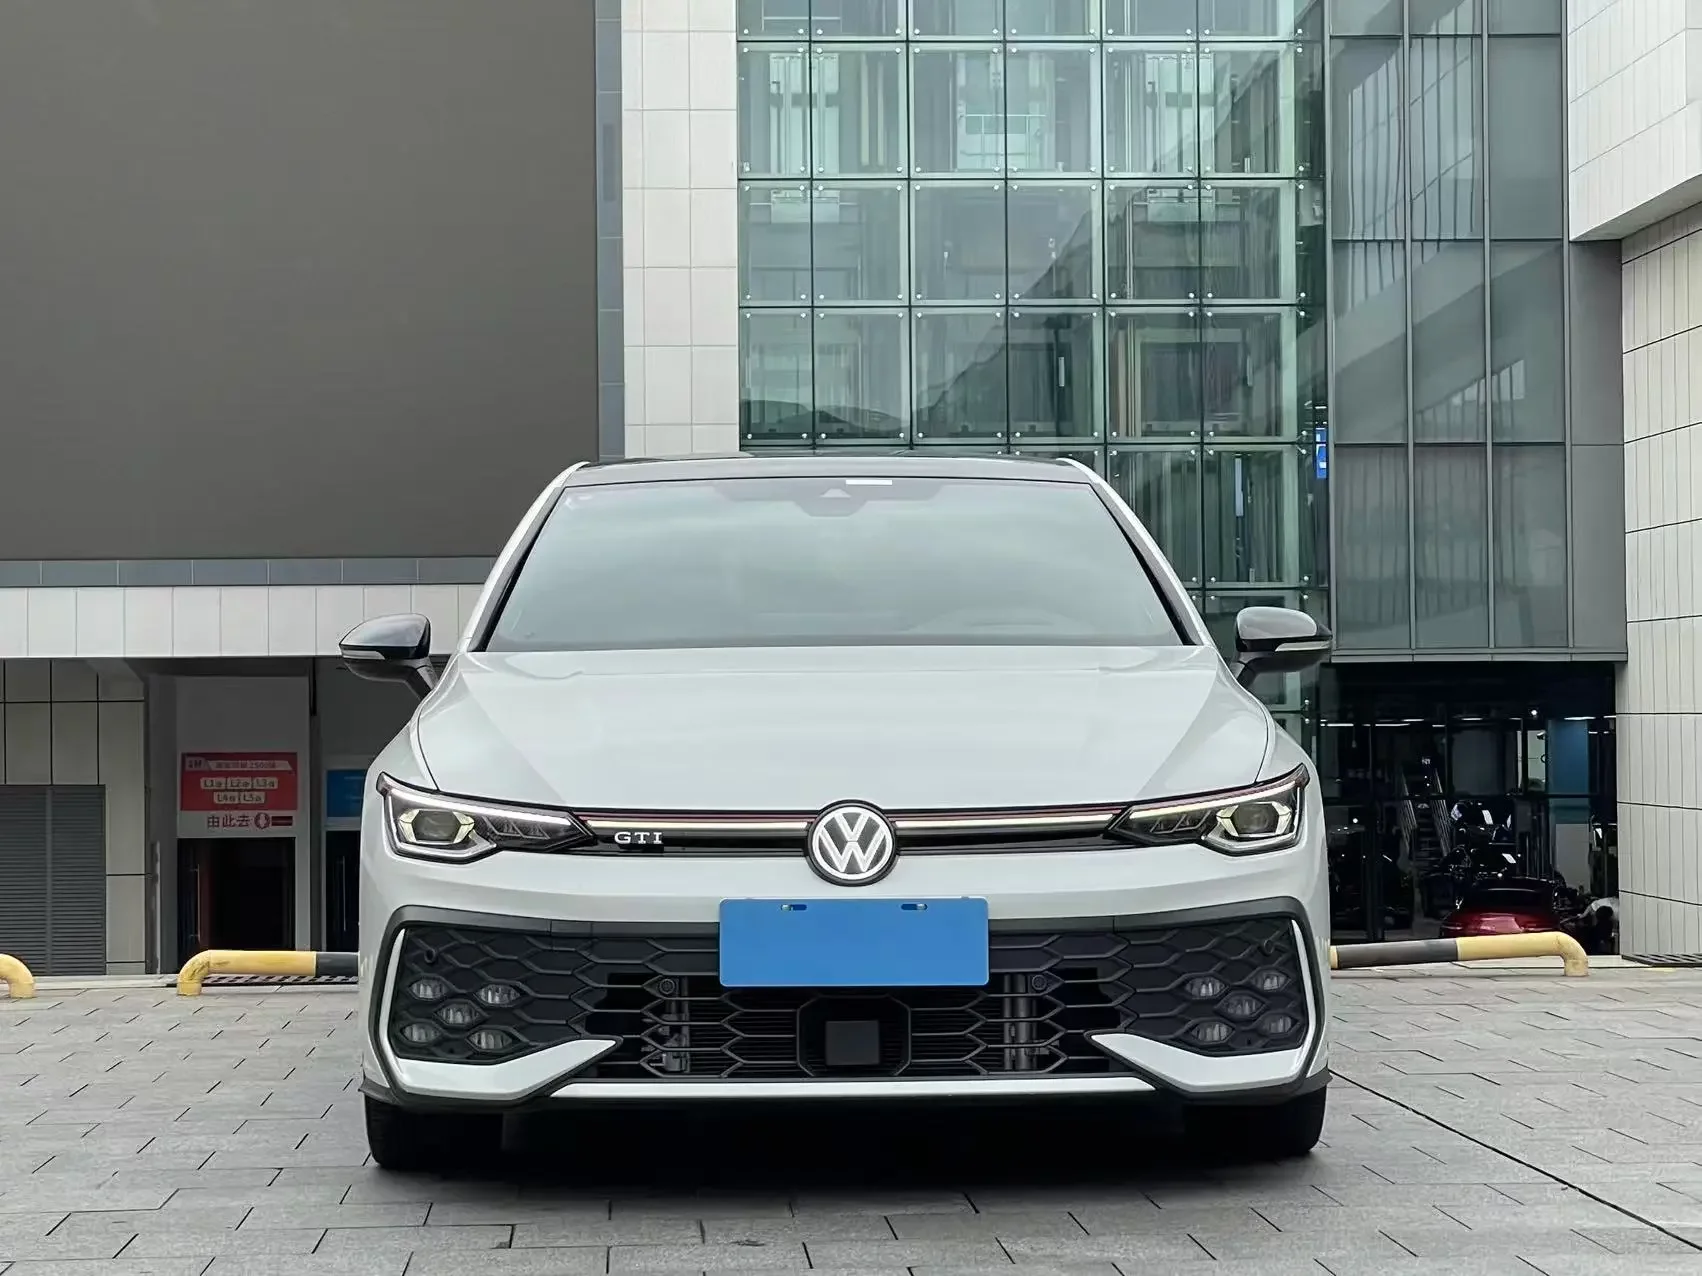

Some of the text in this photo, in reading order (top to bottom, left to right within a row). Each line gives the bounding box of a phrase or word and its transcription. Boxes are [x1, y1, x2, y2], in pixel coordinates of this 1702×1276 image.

[207, 814, 251, 829] 由此去
[614, 831, 663, 845] GTI
